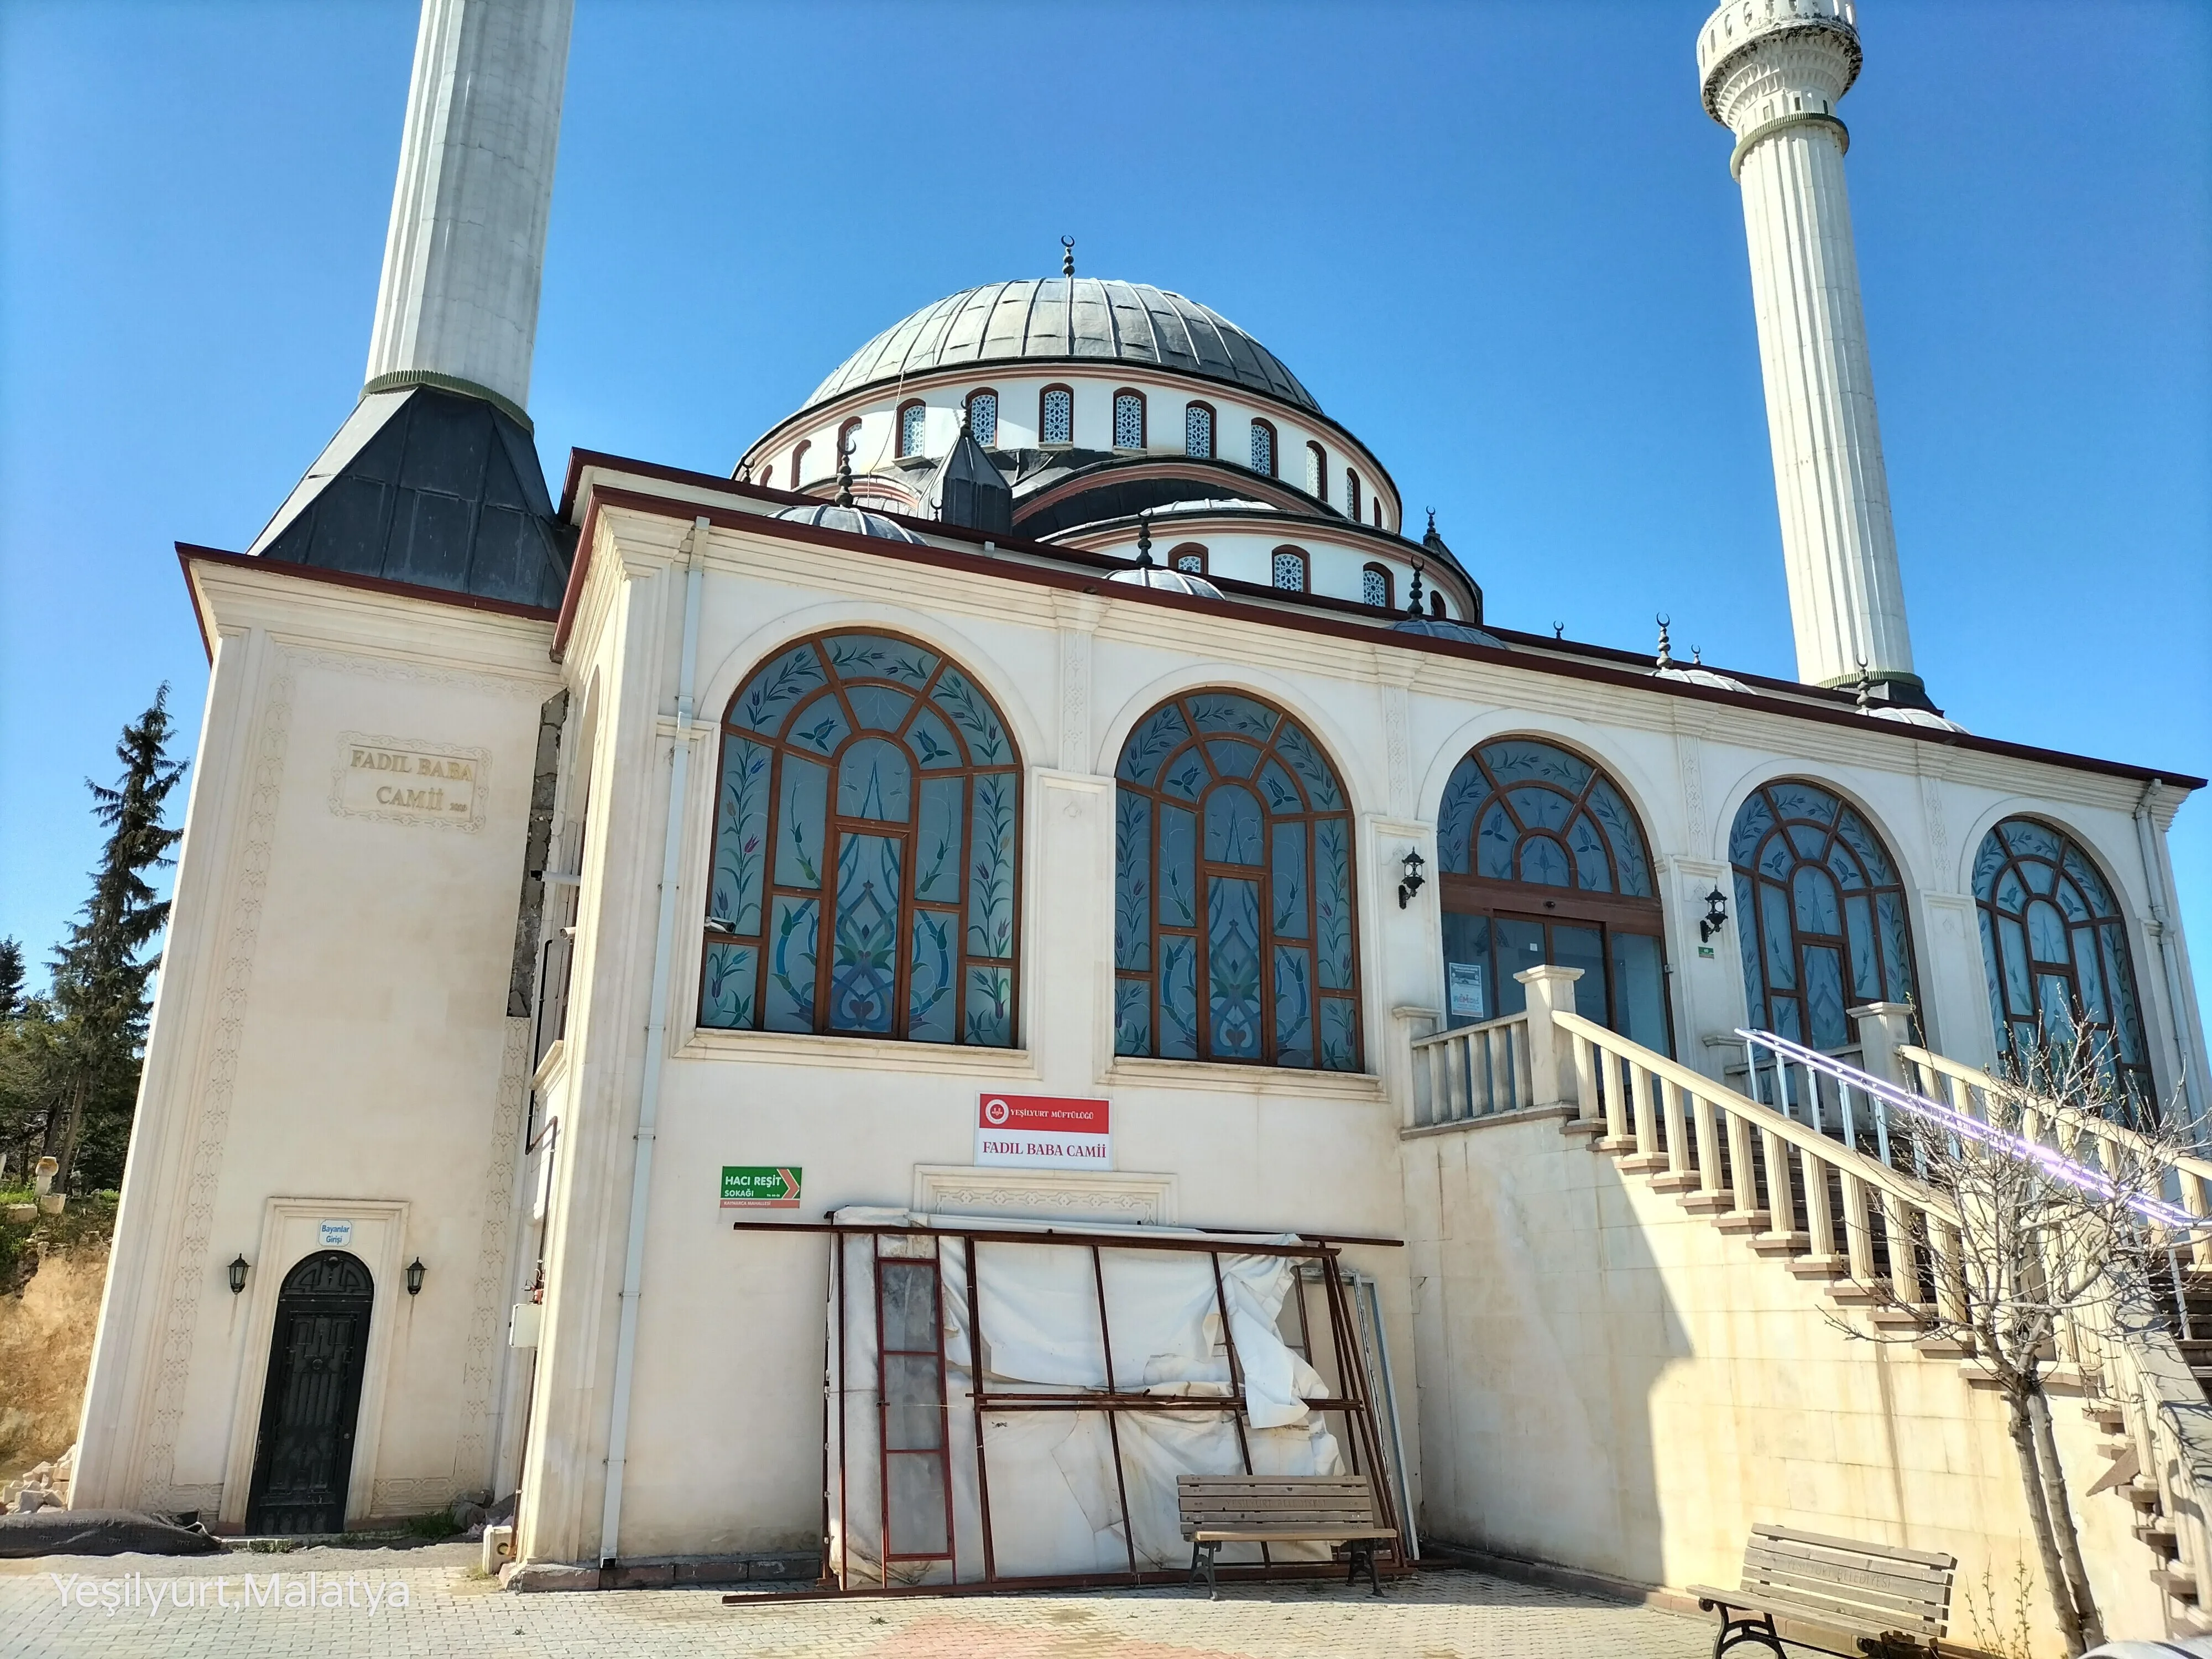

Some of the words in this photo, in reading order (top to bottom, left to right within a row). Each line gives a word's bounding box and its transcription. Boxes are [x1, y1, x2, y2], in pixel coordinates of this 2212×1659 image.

[350, 749, 412, 773] FADIL
[416, 758, 473, 781] BABA
[1010, 1108, 1049, 1118] YEŞİLYURT
[1051, 1110, 1094, 1119] MÜFTÜLÜĞÜ
[983, 1141, 1023, 1155] FADIL
[1027, 1143, 1063, 1156] BABA
[1067, 1144, 1107, 1158] CAMİİ
[725, 1176, 750, 1186] HACI
[754, 1175, 781, 1188] REŞİT
[724, 1188, 754, 1197] SOKAĞI
[321, 1224, 350, 1234] Bayanlar
[326, 1235, 342, 1245] Girişi
